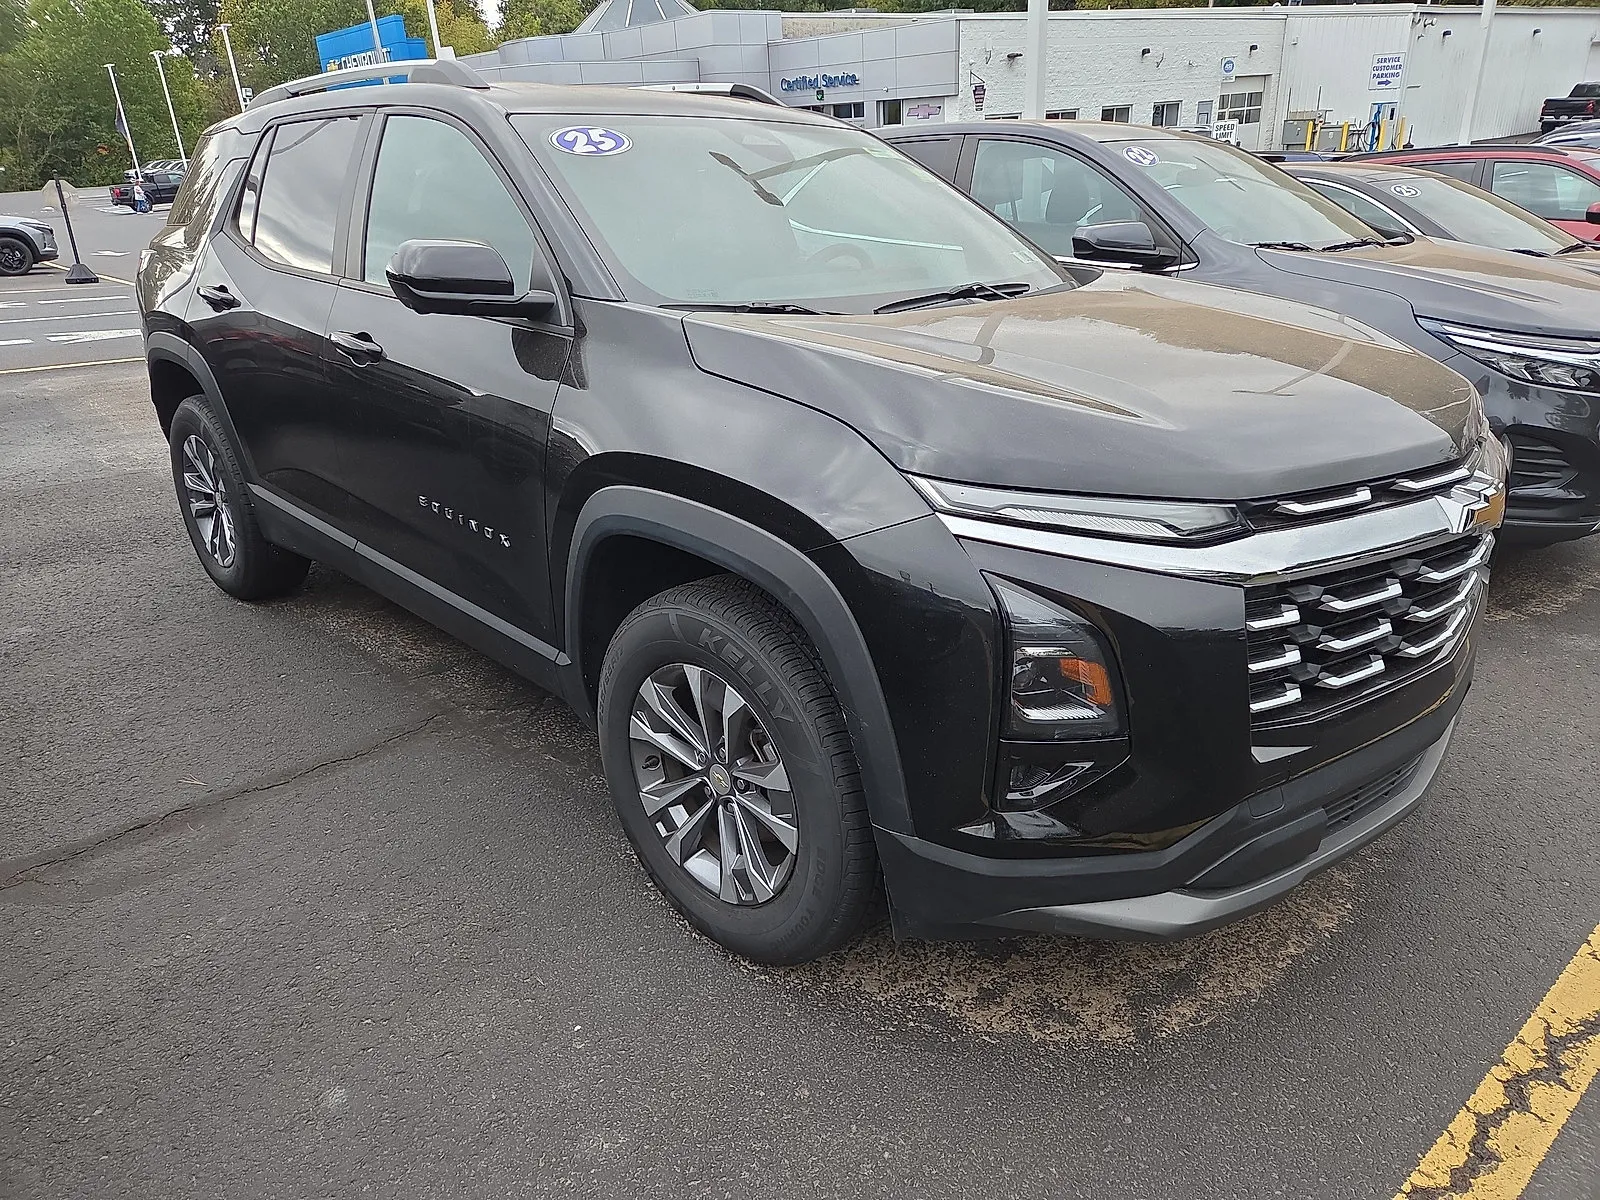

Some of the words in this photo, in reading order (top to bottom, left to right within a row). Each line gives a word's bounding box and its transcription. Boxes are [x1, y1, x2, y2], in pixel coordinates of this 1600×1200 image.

[1377, 56, 1401, 64] SERVICE
[1372, 64, 1403, 72] CUSTOMER
[1372, 71, 1400, 79] PARKING
[780, 74, 820, 92] Certified
[821, 72, 860, 88] Service
[1215, 123, 1235, 132] SPEED
[1215, 131, 1233, 140] LIMIT
[563, 128, 617, 153] 25
[418, 494, 511, 548] EQUINOX
[698, 627, 796, 723] KELLY
